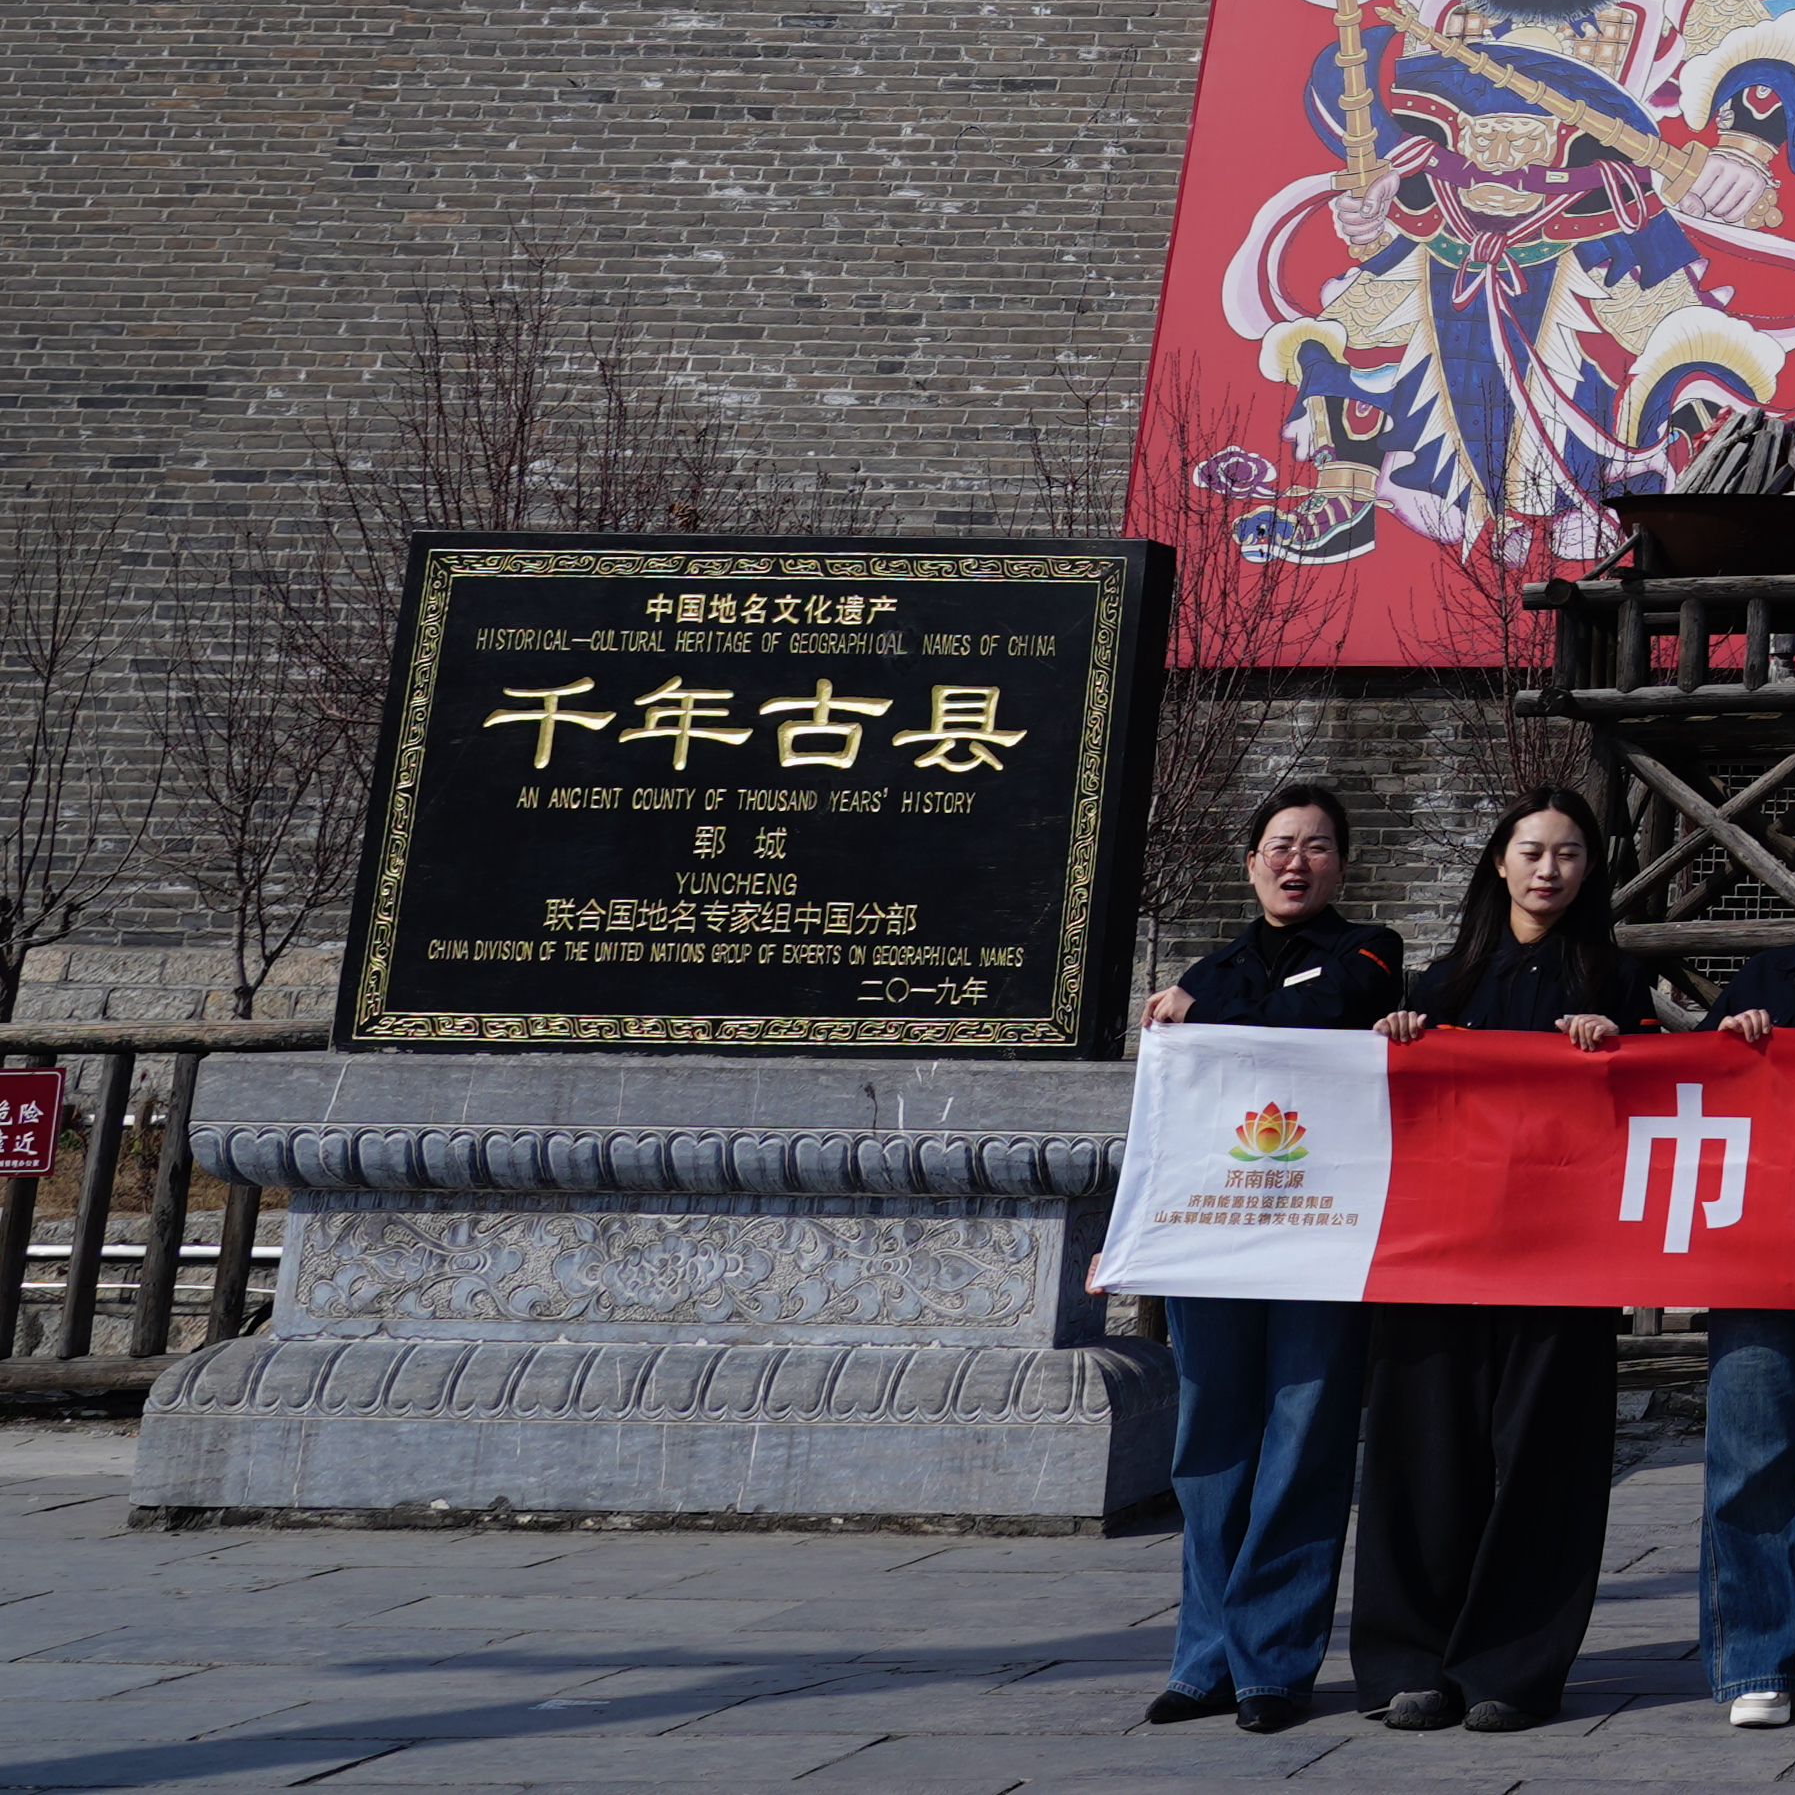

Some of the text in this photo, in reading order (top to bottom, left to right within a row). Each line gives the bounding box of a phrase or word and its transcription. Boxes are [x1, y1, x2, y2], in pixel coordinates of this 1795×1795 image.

[645, 593, 899, 626] 中国地名文化遗产
[675, 630, 753, 654] HERITAGE
[761, 632, 783, 654] OF
[922, 634, 972, 657] NAMES
[980, 635, 1001, 657] OF
[1008, 635, 1057, 657] CHINA
[482, 675, 1028, 773] 千年古县
[516, 786, 540, 810] AN
[547, 787, 623, 810] ANCIENT
[631, 788, 697, 811] COUNTY
[704, 789, 727, 811] OF
[737, 789, 818, 812] THOUSAND
[901, 791, 977, 814] HISTORY
[675, 871, 798, 896] YUNCHENG
[543, 897, 919, 936] 联合国地名专家组中国分部
[428, 939, 1025, 968] CHINA DIVISION OF THE UNITED NATIONS GROUP OF EXPERTS ON GEOGRAPHICAL NAMES
[1224, 1169, 1306, 1190] 济南能源
[1187, 1194, 1335, 1210] 济南能源投资控股集团
